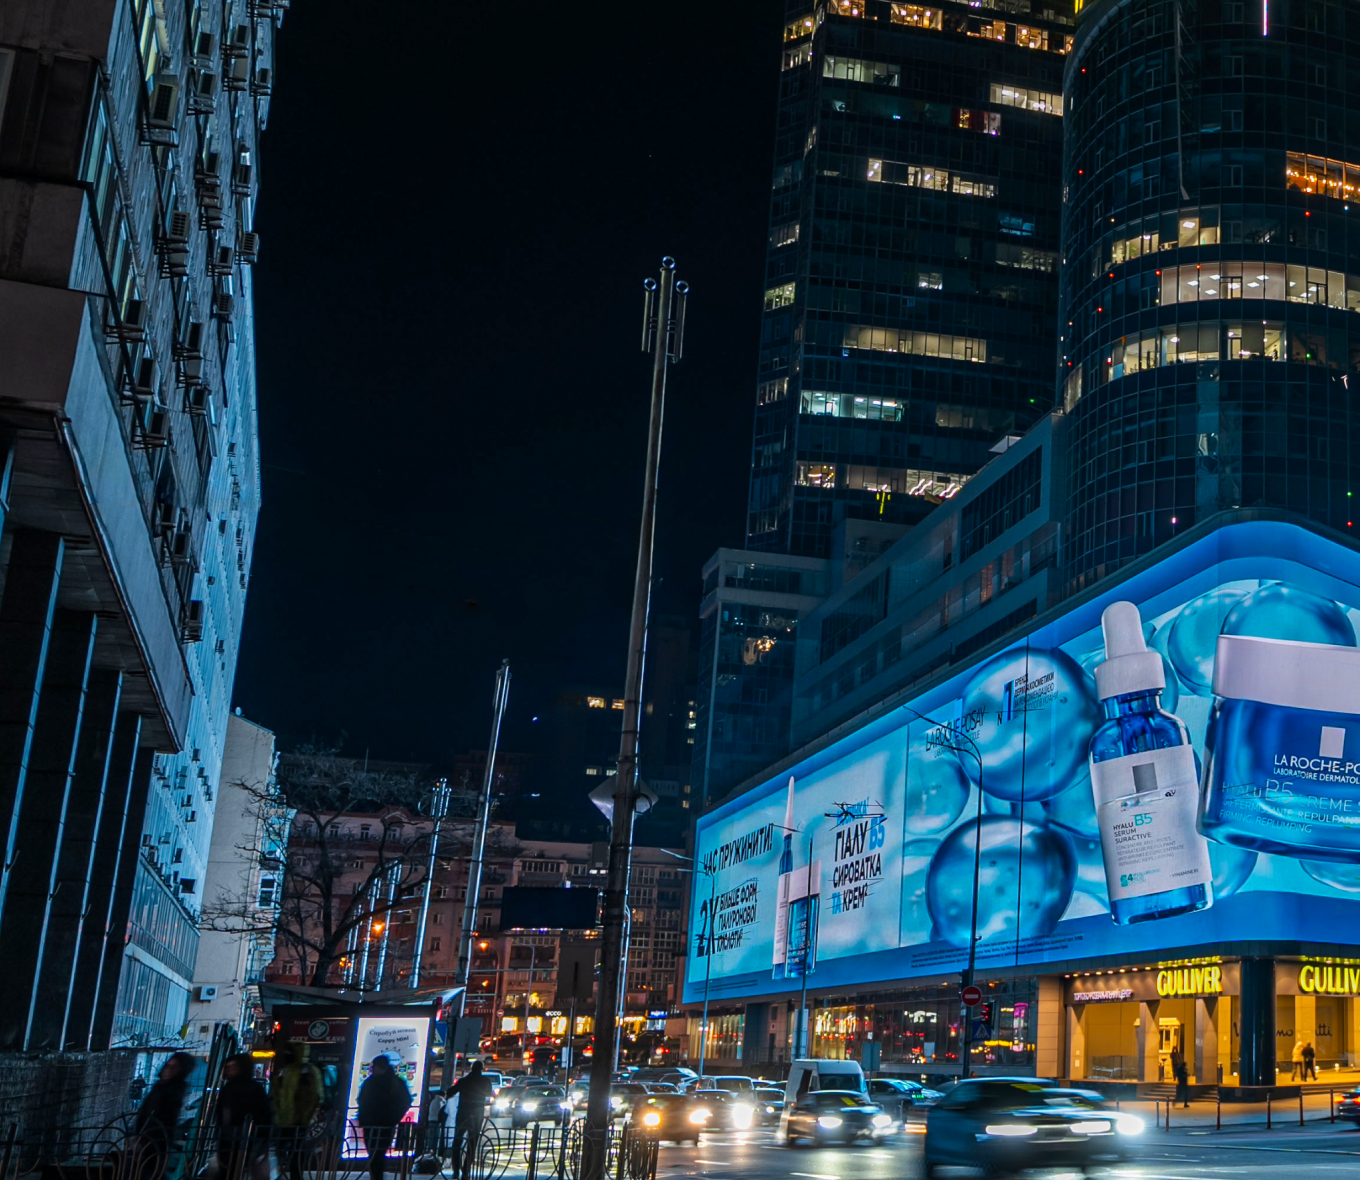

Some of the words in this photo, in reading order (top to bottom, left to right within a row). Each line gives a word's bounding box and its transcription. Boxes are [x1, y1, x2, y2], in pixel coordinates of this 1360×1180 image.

[1273, 753, 1288, 766] LA
[1273, 767, 1318, 781] LABORATOIRE
[1265, 778, 1294, 804] B5
[1112, 822, 1134, 831] HYALU
[1134, 813, 1153, 827] B5
[1113, 828, 1137, 838] SERUM
[718, 824, 774, 871] ПРУЖИНИТИ!
[834, 820, 868, 862] ГІАЛУ
[868, 816, 886, 851] Б5
[833, 853, 882, 889] СИРОВАТКА
[1156, 966, 1223, 996] GULLIVER
